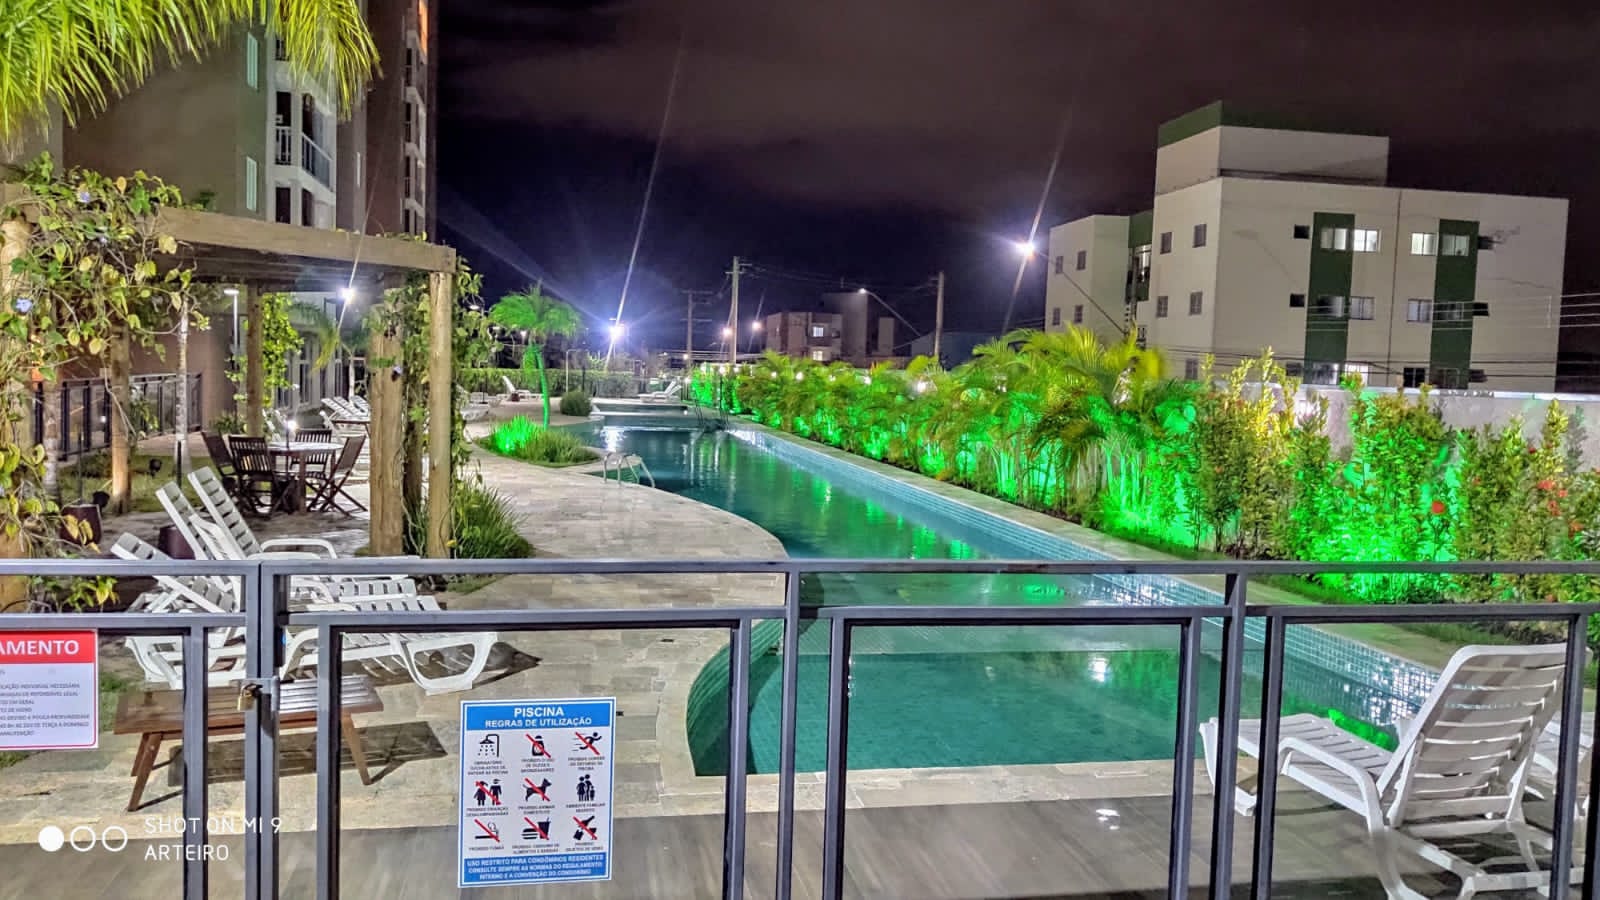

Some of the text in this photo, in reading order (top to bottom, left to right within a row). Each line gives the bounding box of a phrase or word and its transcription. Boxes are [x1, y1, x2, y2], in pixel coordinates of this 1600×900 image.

[514, 707, 564, 718] PISCINA
[485, 717, 592, 728] REGRAS DE UTILIZAÇÃO
[511, 857, 527, 865] PARA
